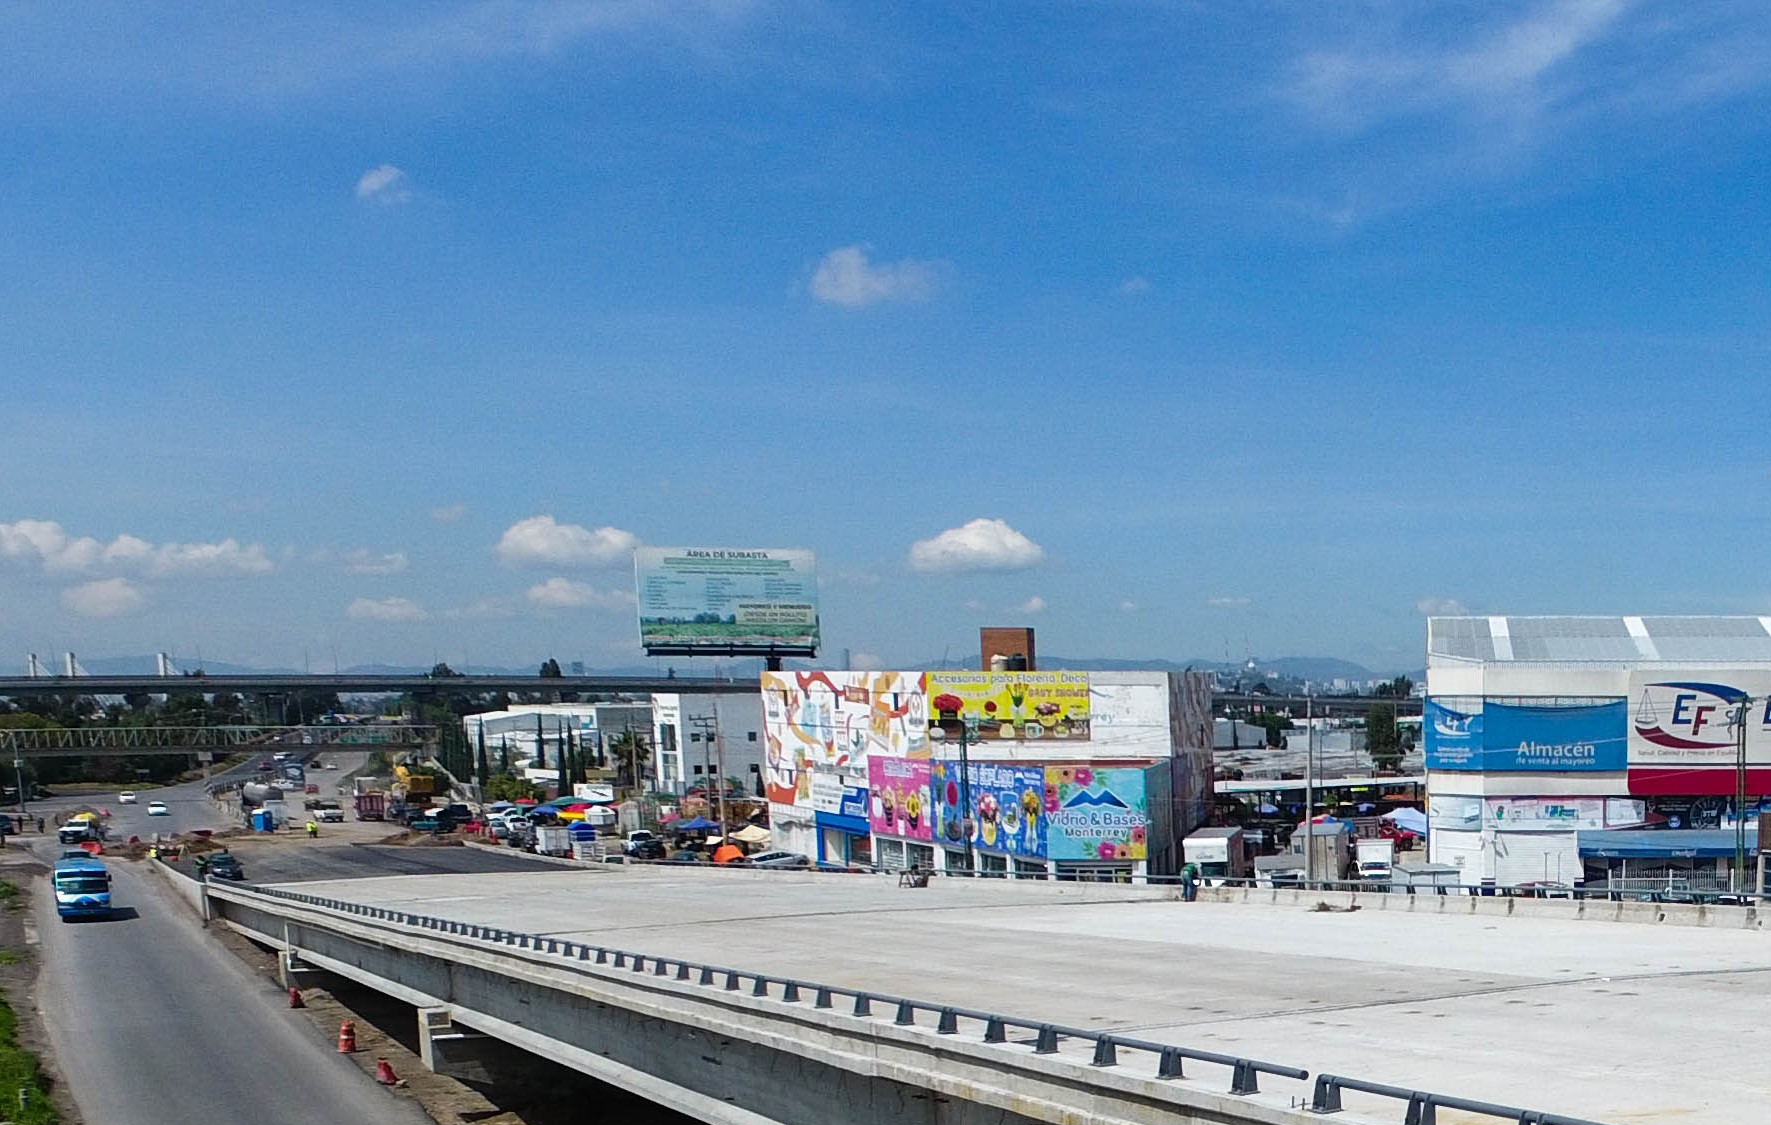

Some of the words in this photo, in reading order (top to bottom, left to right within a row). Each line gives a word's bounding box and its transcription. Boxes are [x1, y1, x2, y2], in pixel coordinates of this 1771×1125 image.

[712, 551, 726, 559] DE
[727, 551, 769, 560] SUBASTA
[1517, 741, 1596, 757] Almacén
[1515, 757, 1526, 765] de
[1527, 757, 1550, 765] venta
[1551, 757, 1559, 765] al
[1560, 757, 1596, 767] mayoreo
[1047, 812, 1088, 826] Vidrio
[1089, 812, 1101, 826] &
[1102, 812, 1146, 826] Bases
[1064, 828, 1129, 838] Monterrey
